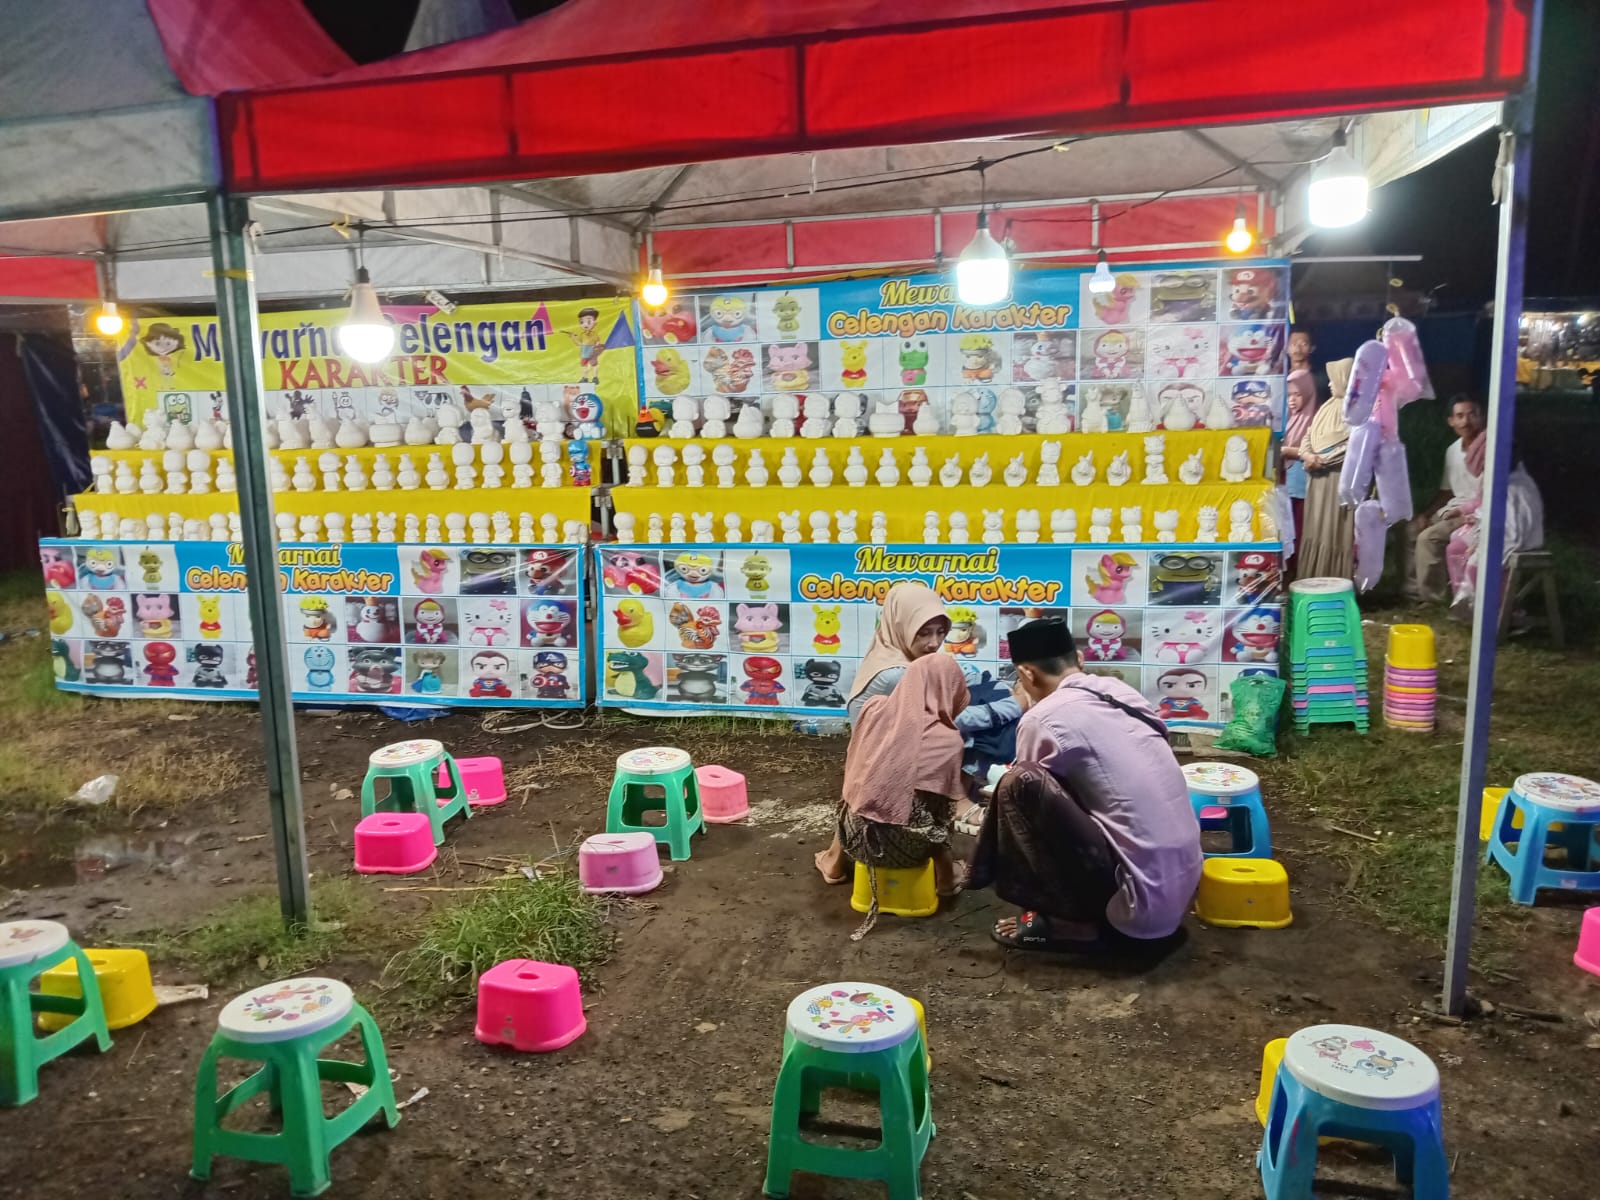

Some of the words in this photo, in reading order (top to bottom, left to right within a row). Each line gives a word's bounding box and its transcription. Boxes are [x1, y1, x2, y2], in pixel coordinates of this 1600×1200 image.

[828, 309, 948, 338] Celengan
[952, 303, 1071, 331] Karakter
[383, 310, 547, 363] elengan
[278, 354, 449, 388] KARAKTER
[228, 542, 341, 566] Marnai
[856, 545, 997, 573] Mewarnai
[292, 567, 393, 592] Karakter
[934, 574, 1060, 603] Karakter
